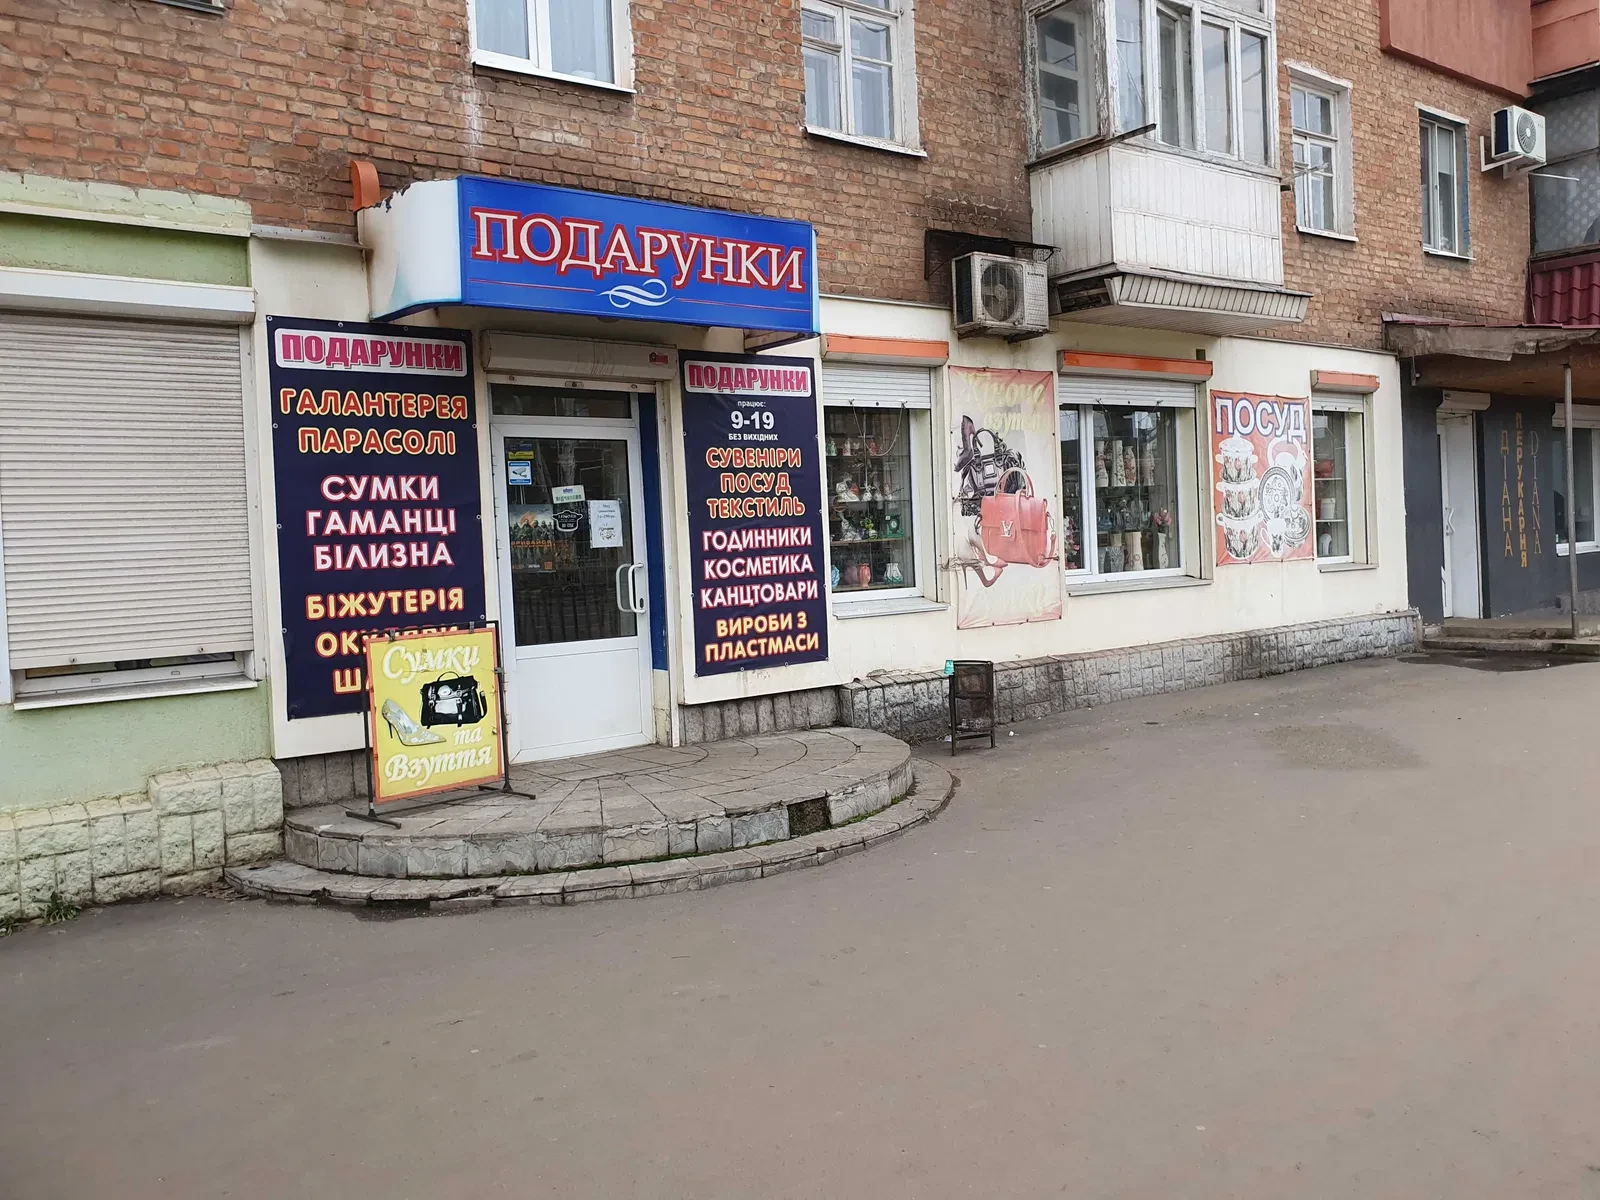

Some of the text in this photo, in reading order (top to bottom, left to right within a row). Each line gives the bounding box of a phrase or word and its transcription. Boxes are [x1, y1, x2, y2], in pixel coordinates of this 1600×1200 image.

[471, 207, 806, 292] ПОДАРУНКИ
[281, 334, 463, 371] ПОДАРУНКИ
[688, 364, 809, 393] ПОДАРУНКИ
[280, 388, 468, 419] ГАЛАНТЕРЕЯ
[730, 410, 775, 430] 9-19
[1215, 397, 1307, 444] ПОСУД
[298, 427, 456, 455] ПАРАСОЛІ
[728, 433, 779, 442] БЕЗ ВИХІДНИХ
[706, 447, 801, 468] СУВЕНІРИ
[321, 475, 440, 501] СУМКИ
[720, 472, 791, 495] ПОСУД
[1500, 430, 1514, 557] ДІАНА
[1515, 412, 1528, 568] ПЕРУКАРНЯ
[1530, 430, 1542, 554] DIANA
[707, 496, 805, 518] ТЕКСТИЛЬ
[306, 508, 457, 536] ГАМАНЦІ
[702, 526, 813, 552] ГОДИННИКИ
[313, 541, 455, 571] БІЛИЗНА
[703, 553, 815, 580] КОСМЕТИКА
[305, 587, 465, 621] БІЖУТЕРІЯ
[700, 580, 819, 609] КАНЦТОВАРИ
[716, 612, 793, 638] ВИРОБИ
[704, 632, 819, 663] ПЛАСТМАСИ
[382, 645, 480, 685] Сумки
[454, 727, 482, 746] та
[385, 745, 493, 787] Взуття
